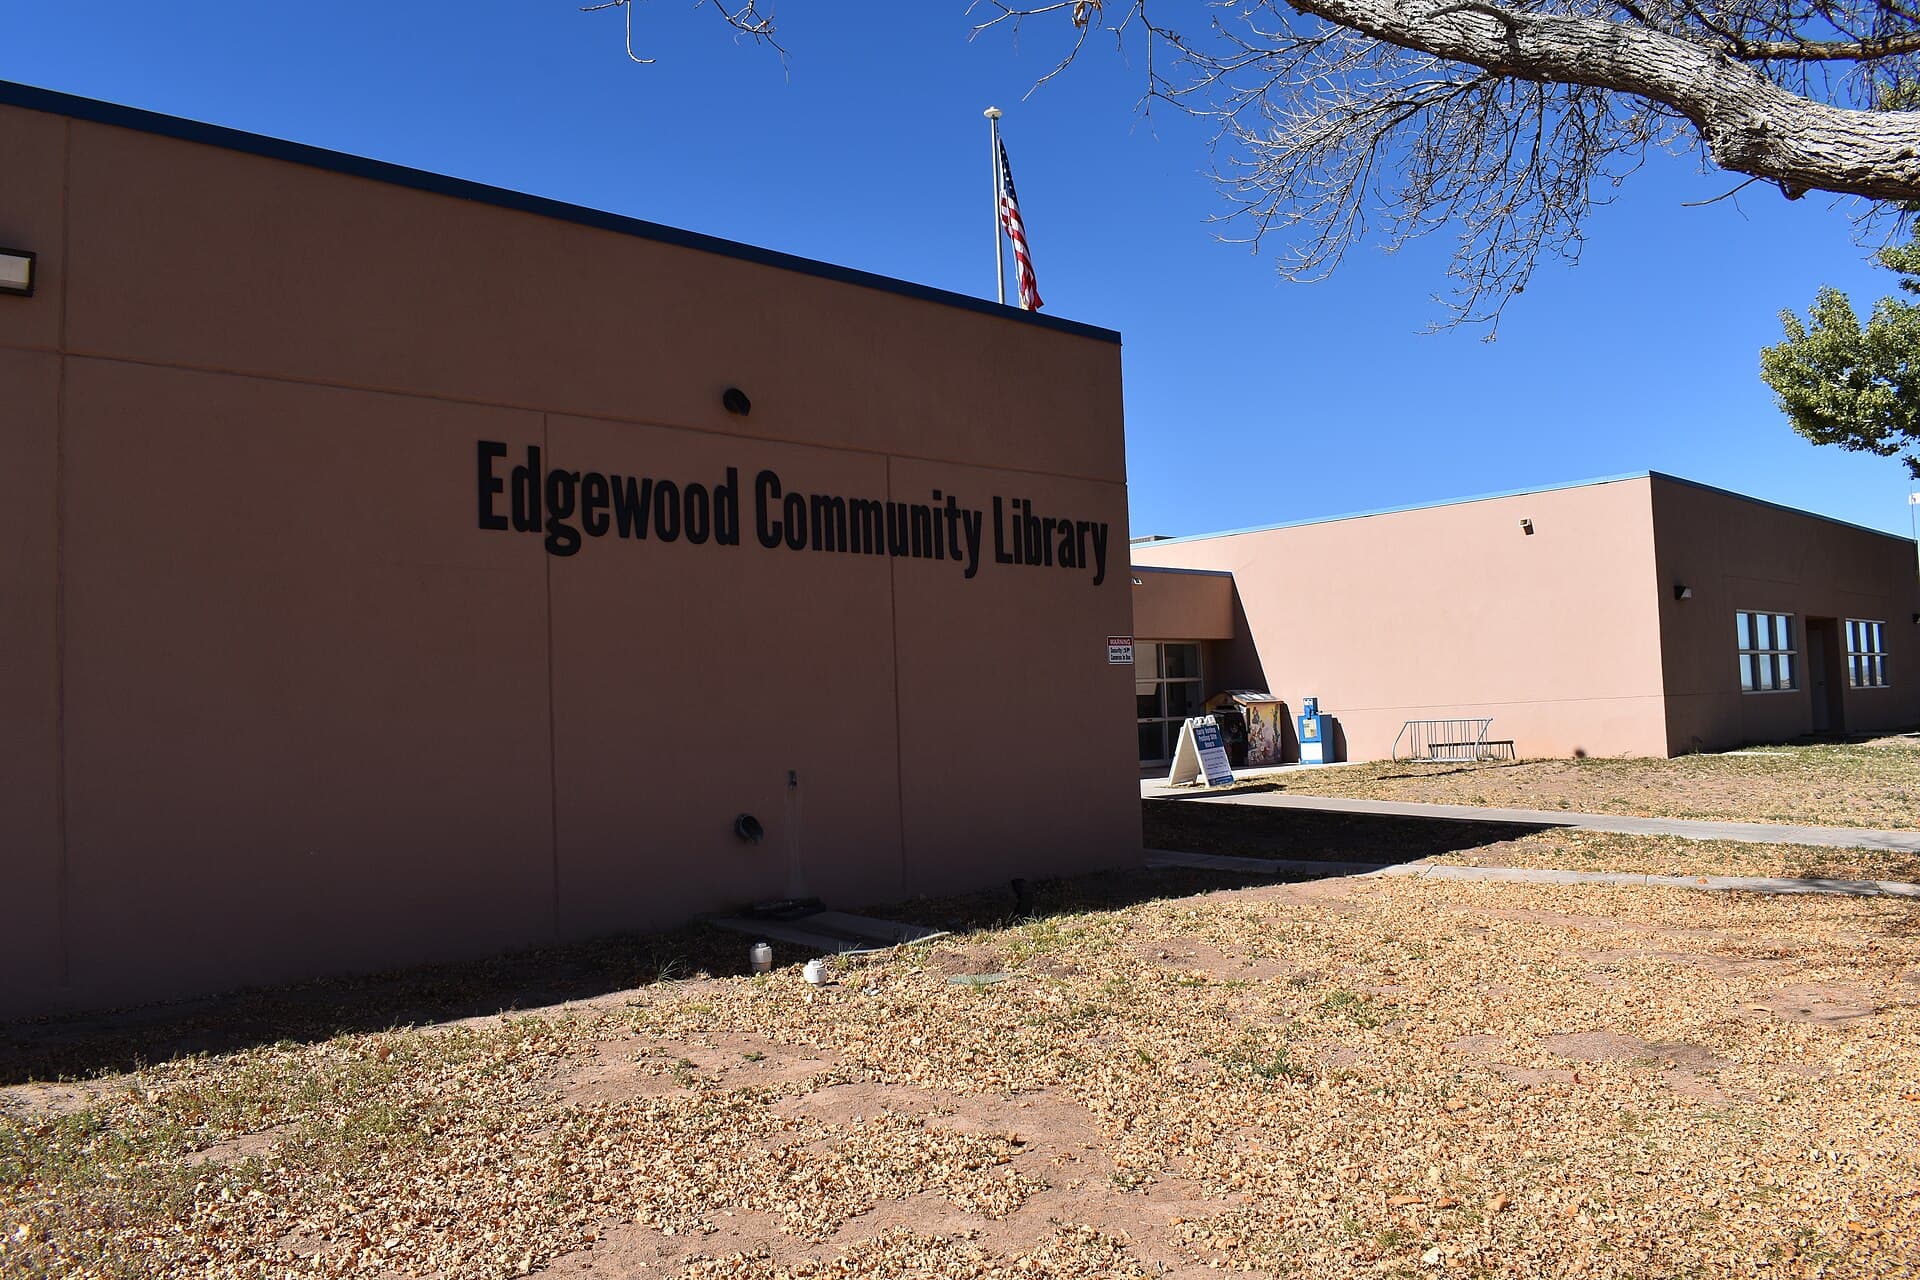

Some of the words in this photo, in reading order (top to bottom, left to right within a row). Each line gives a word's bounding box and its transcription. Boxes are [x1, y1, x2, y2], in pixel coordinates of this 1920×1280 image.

[477, 439, 740, 557] Edgewood
[754, 469, 983, 579] Community
[992, 495, 1109, 586] Library
